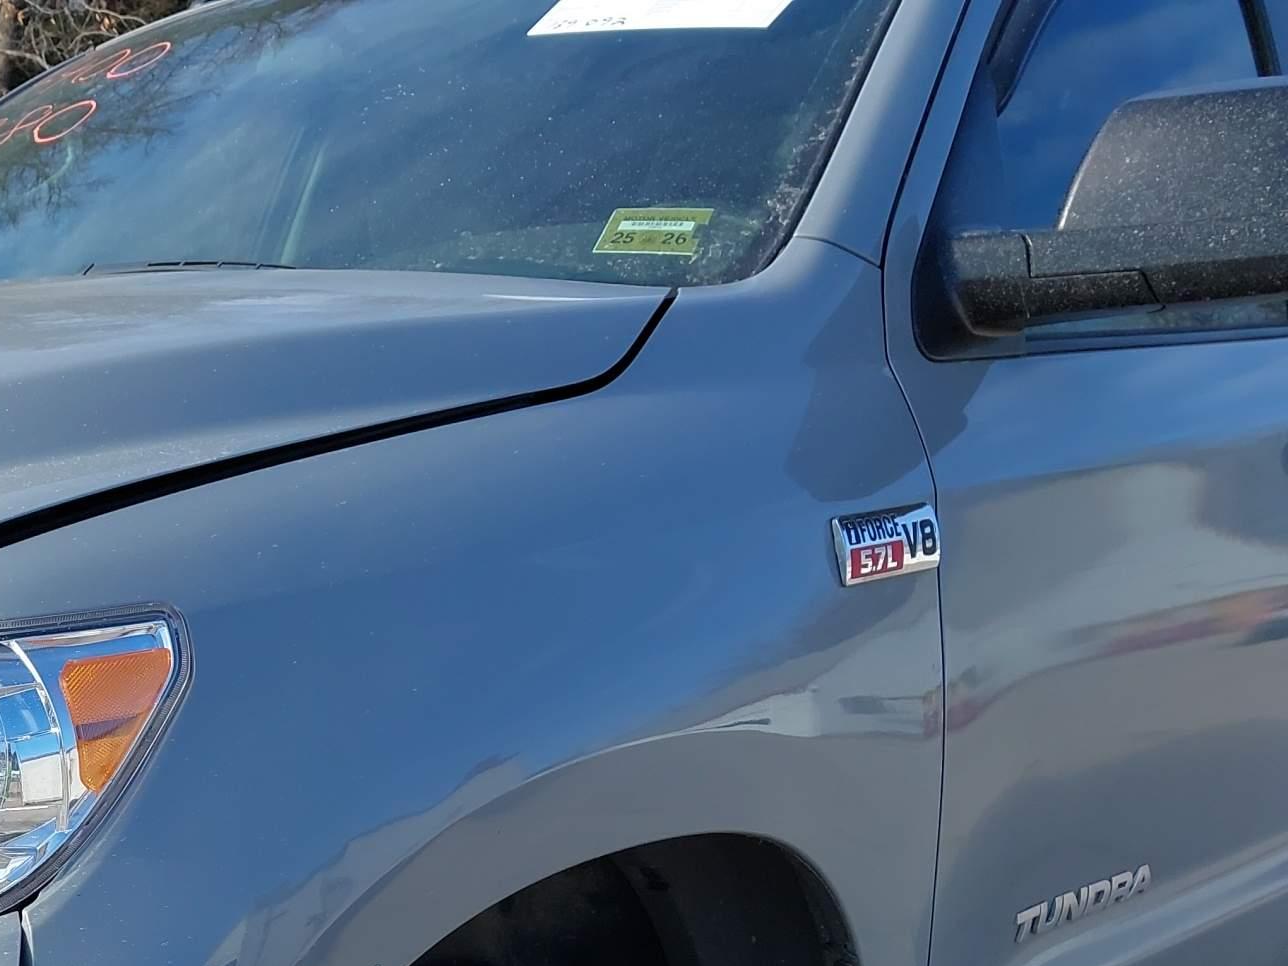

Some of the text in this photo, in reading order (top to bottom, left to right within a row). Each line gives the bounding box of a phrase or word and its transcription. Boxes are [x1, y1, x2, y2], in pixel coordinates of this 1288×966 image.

[610, 231, 688, 246] 25 26
[901, 517, 938, 560] V8
[859, 546, 899, 575] 5.7L
[1014, 864, 1153, 944] TUNDRA
